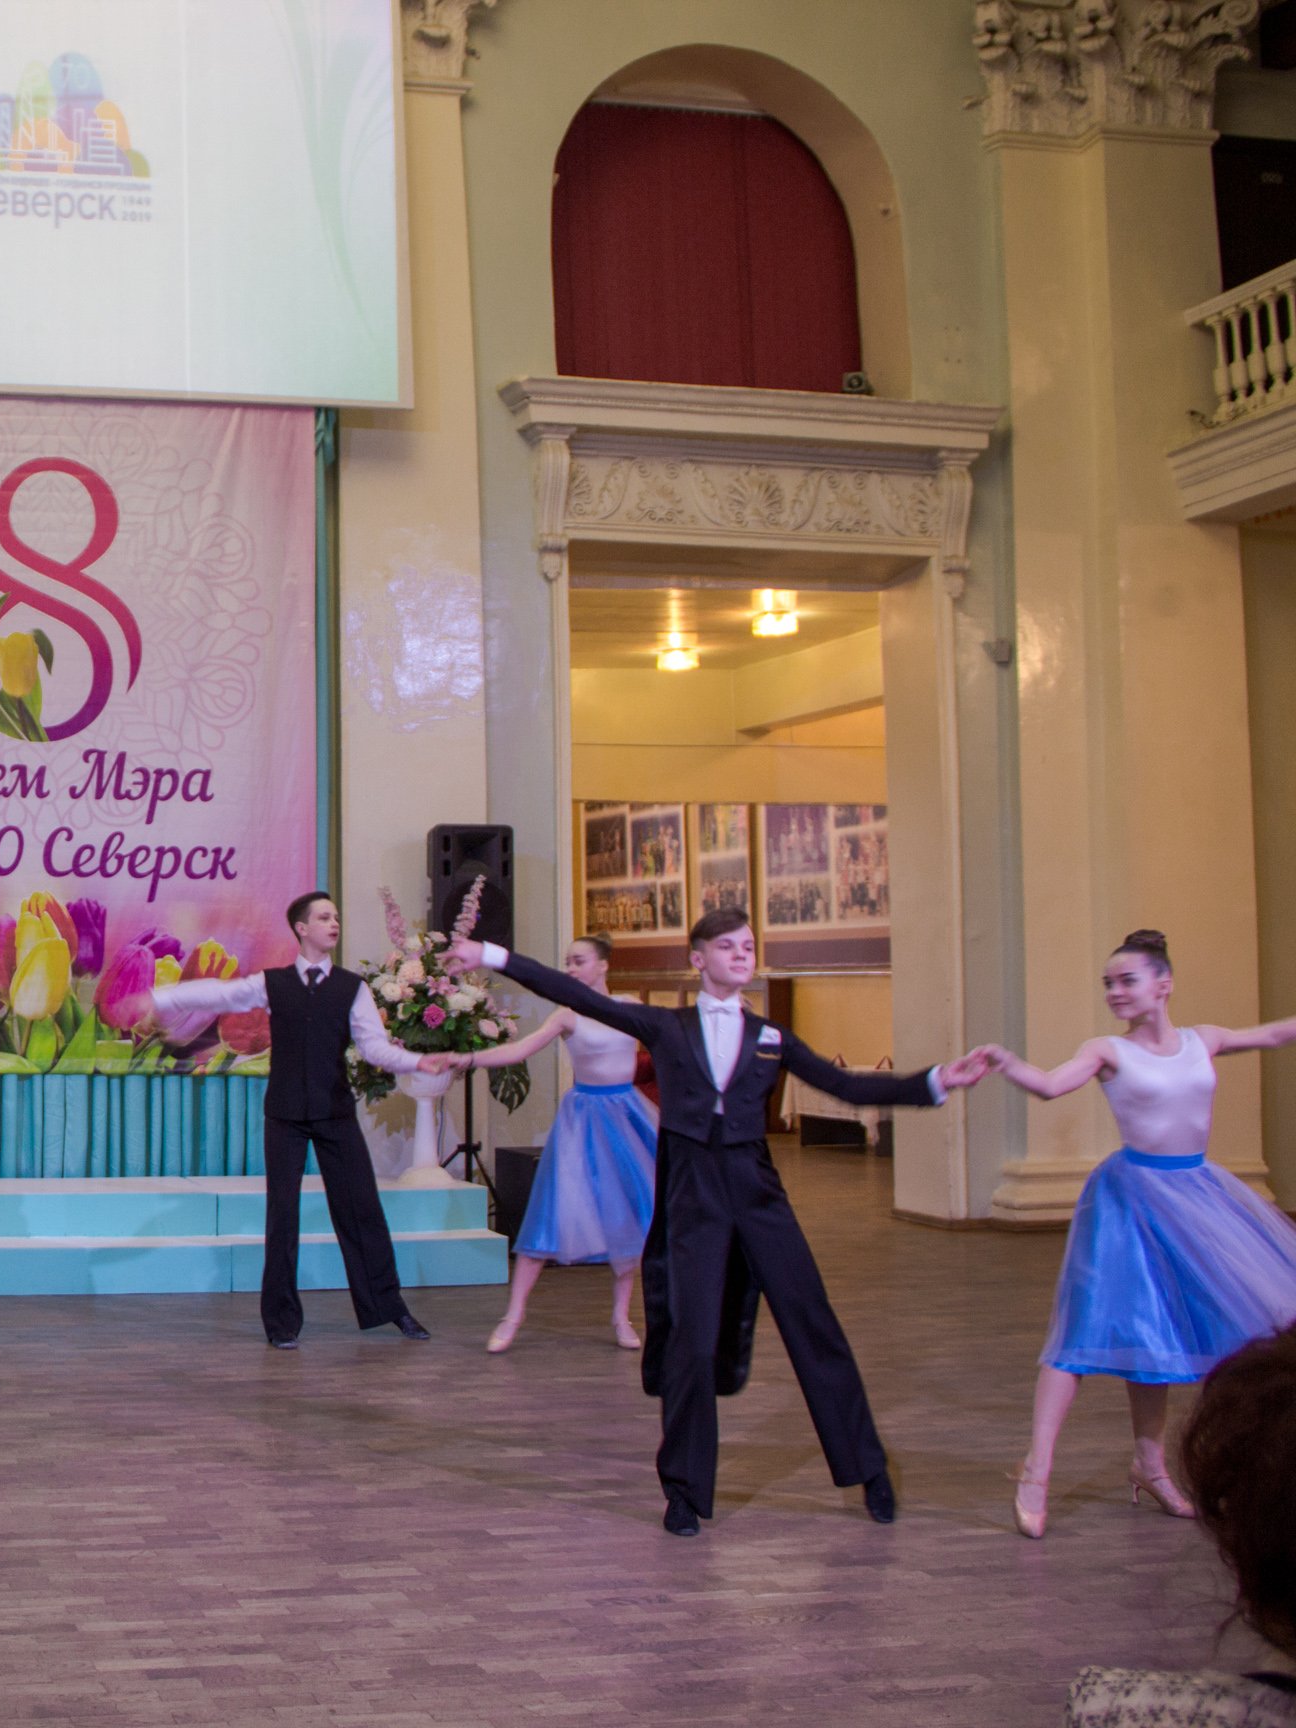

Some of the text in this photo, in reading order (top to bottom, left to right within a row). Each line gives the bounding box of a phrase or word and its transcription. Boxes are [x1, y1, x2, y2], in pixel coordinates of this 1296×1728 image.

[121, 210, 153, 222] 2019
[69, 748, 214, 825] Мэра
[42, 826, 238, 903] Северск
